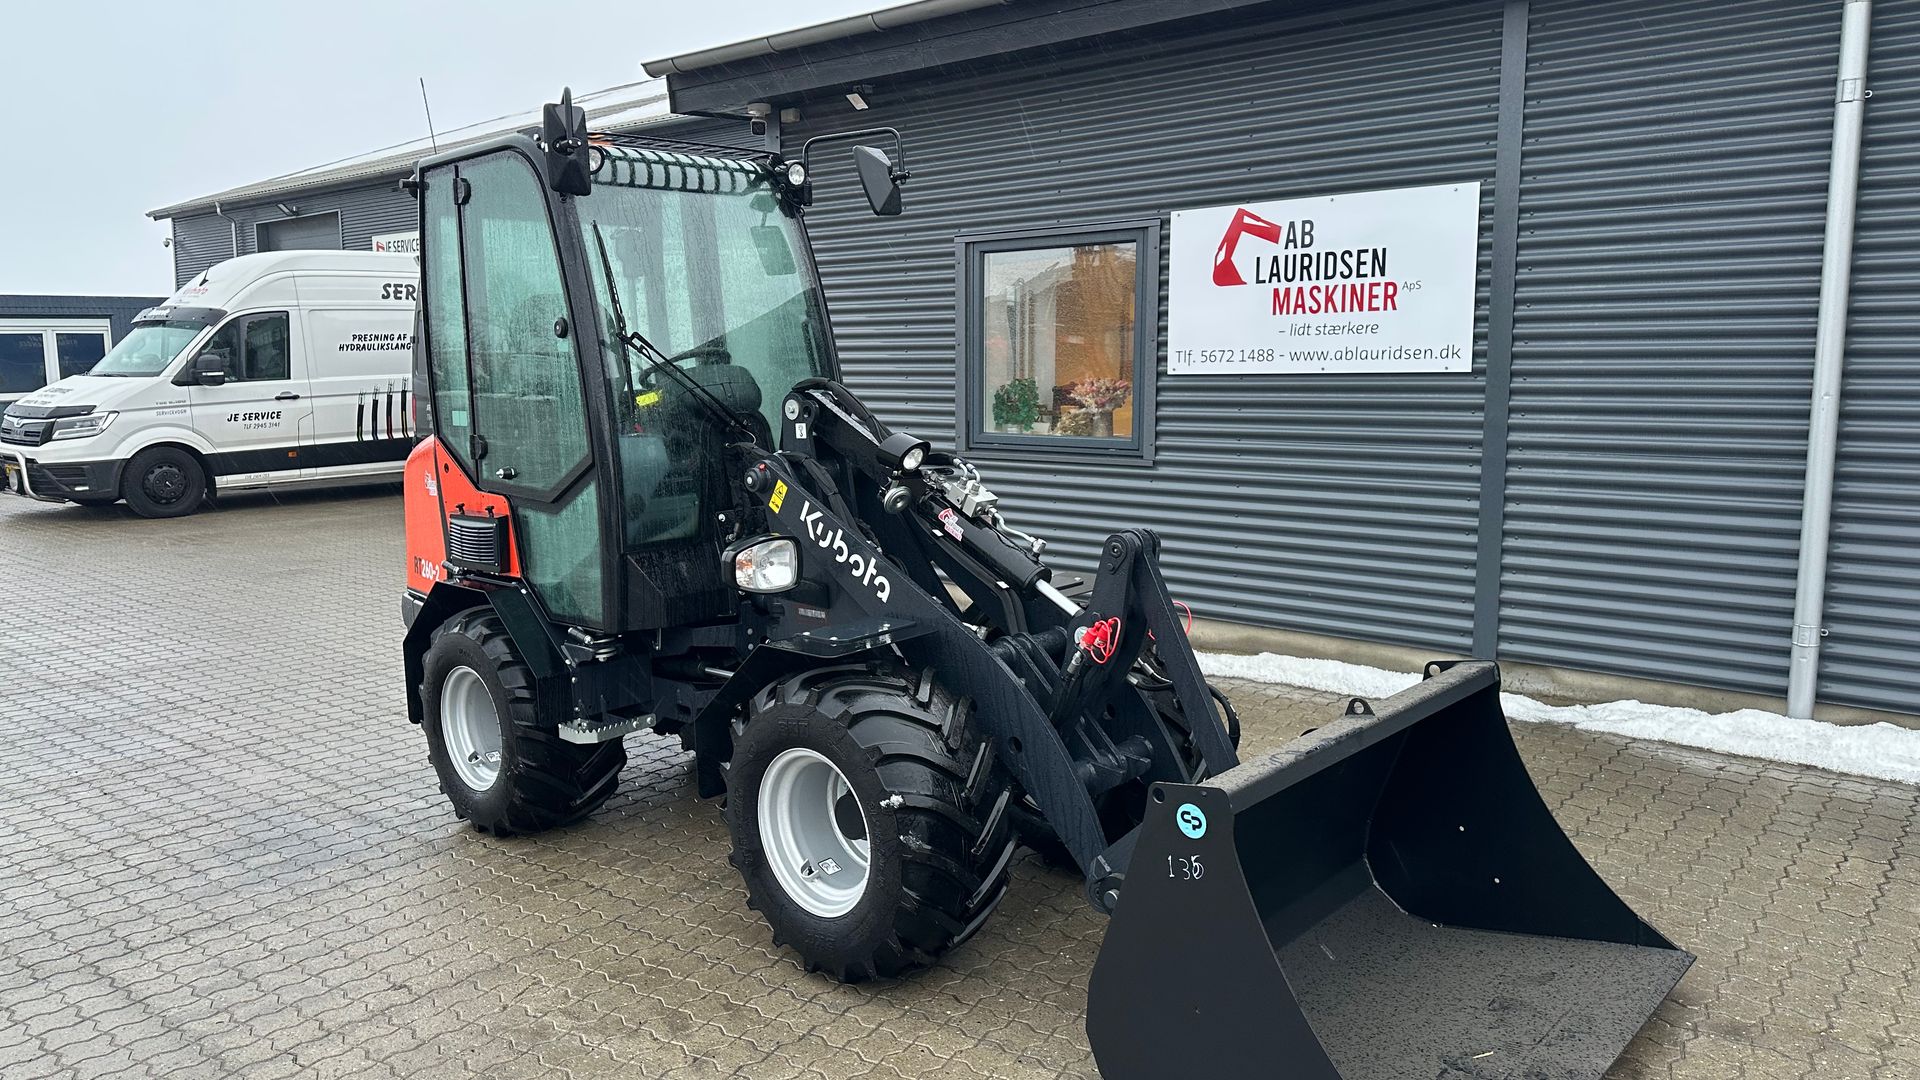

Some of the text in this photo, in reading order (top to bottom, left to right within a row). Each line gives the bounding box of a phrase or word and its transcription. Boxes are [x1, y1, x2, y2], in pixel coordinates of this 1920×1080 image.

[1284, 219, 1314, 250] AB
[1255, 247, 1387, 284] LAURIDSEN
[1272, 279, 1422, 316] MASKINER ApS
[352, 333, 408, 343] PRESNING AF
[1289, 322, 1312, 337] lidt
[1314, 321, 1380, 336] stærkere
[338, 342, 412, 352] HYDRAULIKSLANG
[1175, 349, 1196, 367] Tlf.
[1200, 348, 1235, 364] 5672
[1238, 348, 1275, 363] 1488
[1288, 343, 1462, 362] www.ablauridsen.dk
[227, 411, 282, 422] JE SERVICE
[800, 500, 891, 603] Kubota
